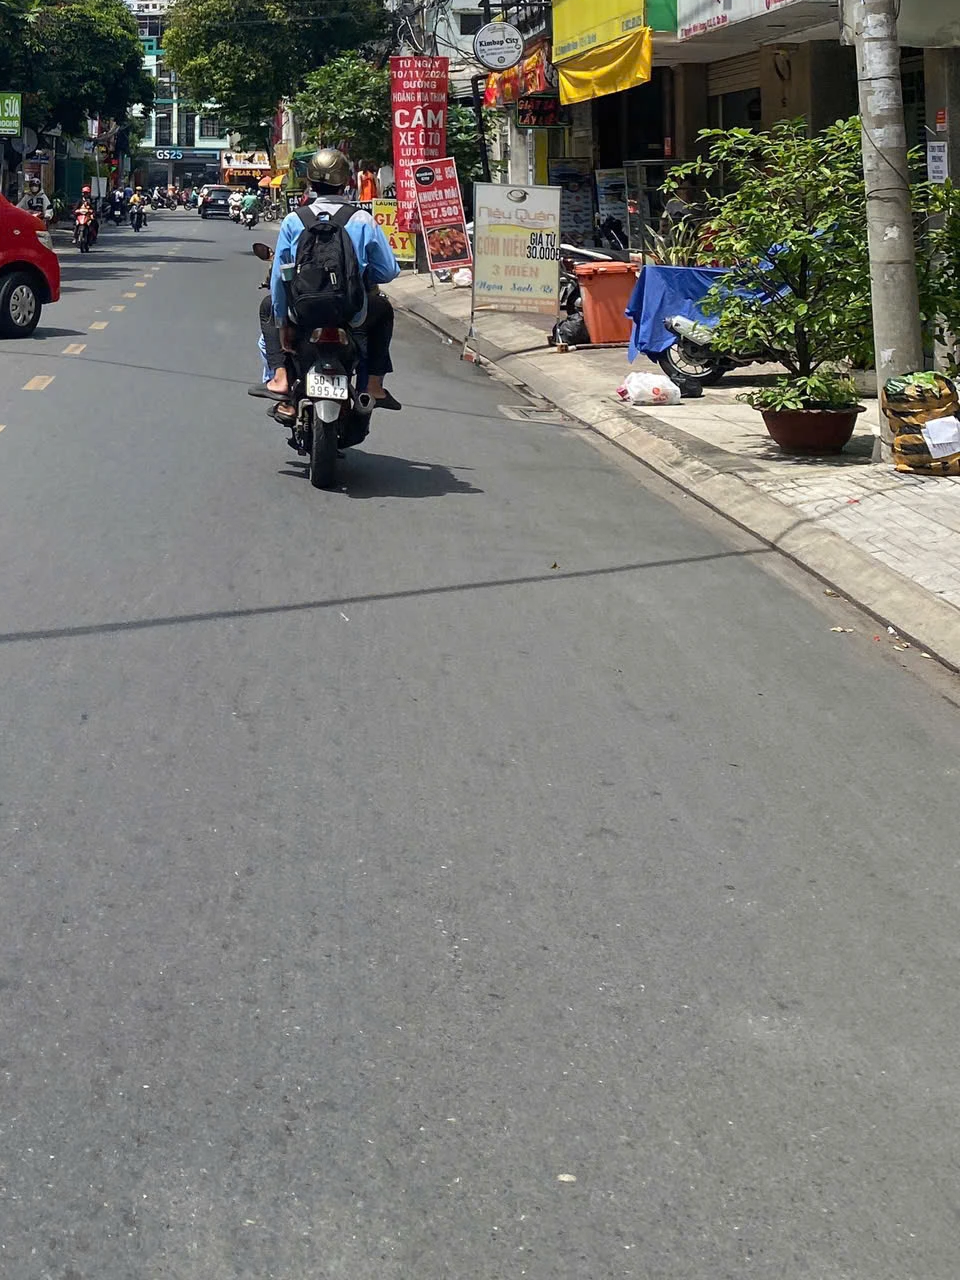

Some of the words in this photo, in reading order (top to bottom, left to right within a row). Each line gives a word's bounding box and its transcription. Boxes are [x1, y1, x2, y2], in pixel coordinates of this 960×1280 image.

[479, 39, 505, 47] Kimbap
[505, 37, 519, 45] City
[400, 58, 411, 68] TỪ
[392, 70, 447, 79] 10/11/2024
[403, 79, 437, 89] ĐƯỜNG
[4, 96, 20, 117] SỮA
[394, 103, 444, 129] CẤM
[399, 131, 415, 146] XE
[419, 129, 426, 146] Ô
[156, 150, 183, 160] GS25
[401, 147, 417, 157] LƯU
[430, 205, 459, 219] 17.500
[530, 230, 544, 247] GIÁ
[545, 231, 557, 248] TỪ
[310, 386, 345, 398] 395.42
